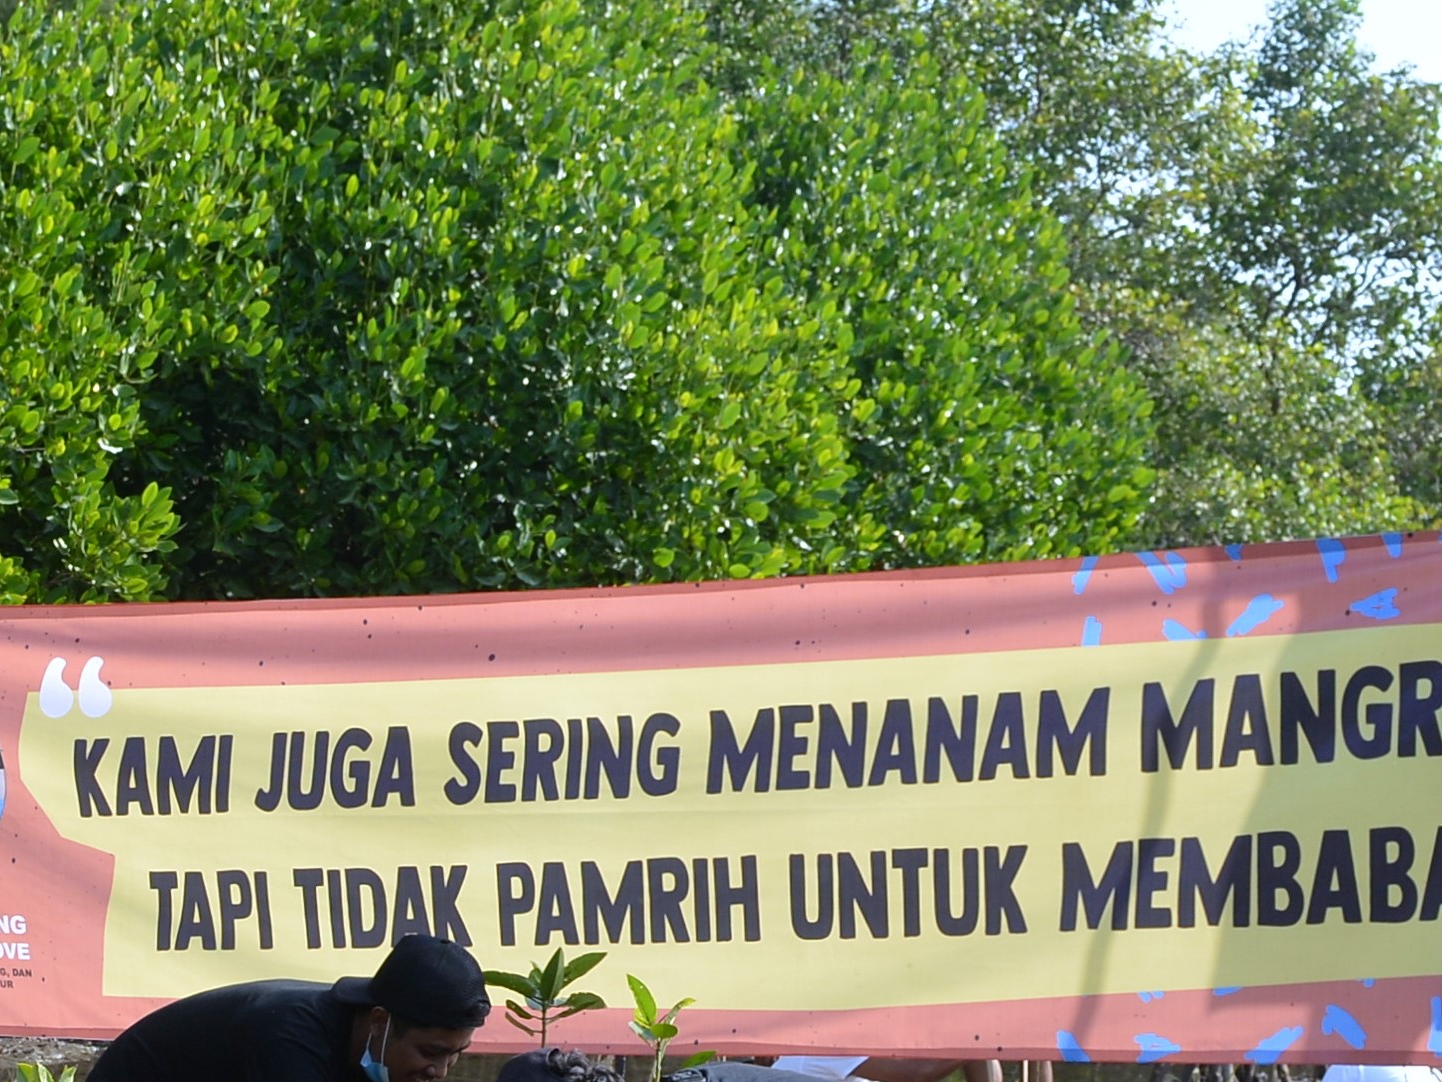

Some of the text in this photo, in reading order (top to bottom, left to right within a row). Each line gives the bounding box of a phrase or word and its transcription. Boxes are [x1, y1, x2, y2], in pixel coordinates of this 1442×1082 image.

[72, 733, 233, 818] KAMI
[254, 725, 415, 812] JUGA
[443, 711, 682, 806] SERING
[705, 686, 1111, 795] MENANAM
[149, 868, 274, 951] TAPI
[293, 865, 473, 949] TIDAK
[495, 855, 761, 947] PAMRIH
[789, 844, 1028, 941] UNTUK
[12, 967, 33, 978] DAN
